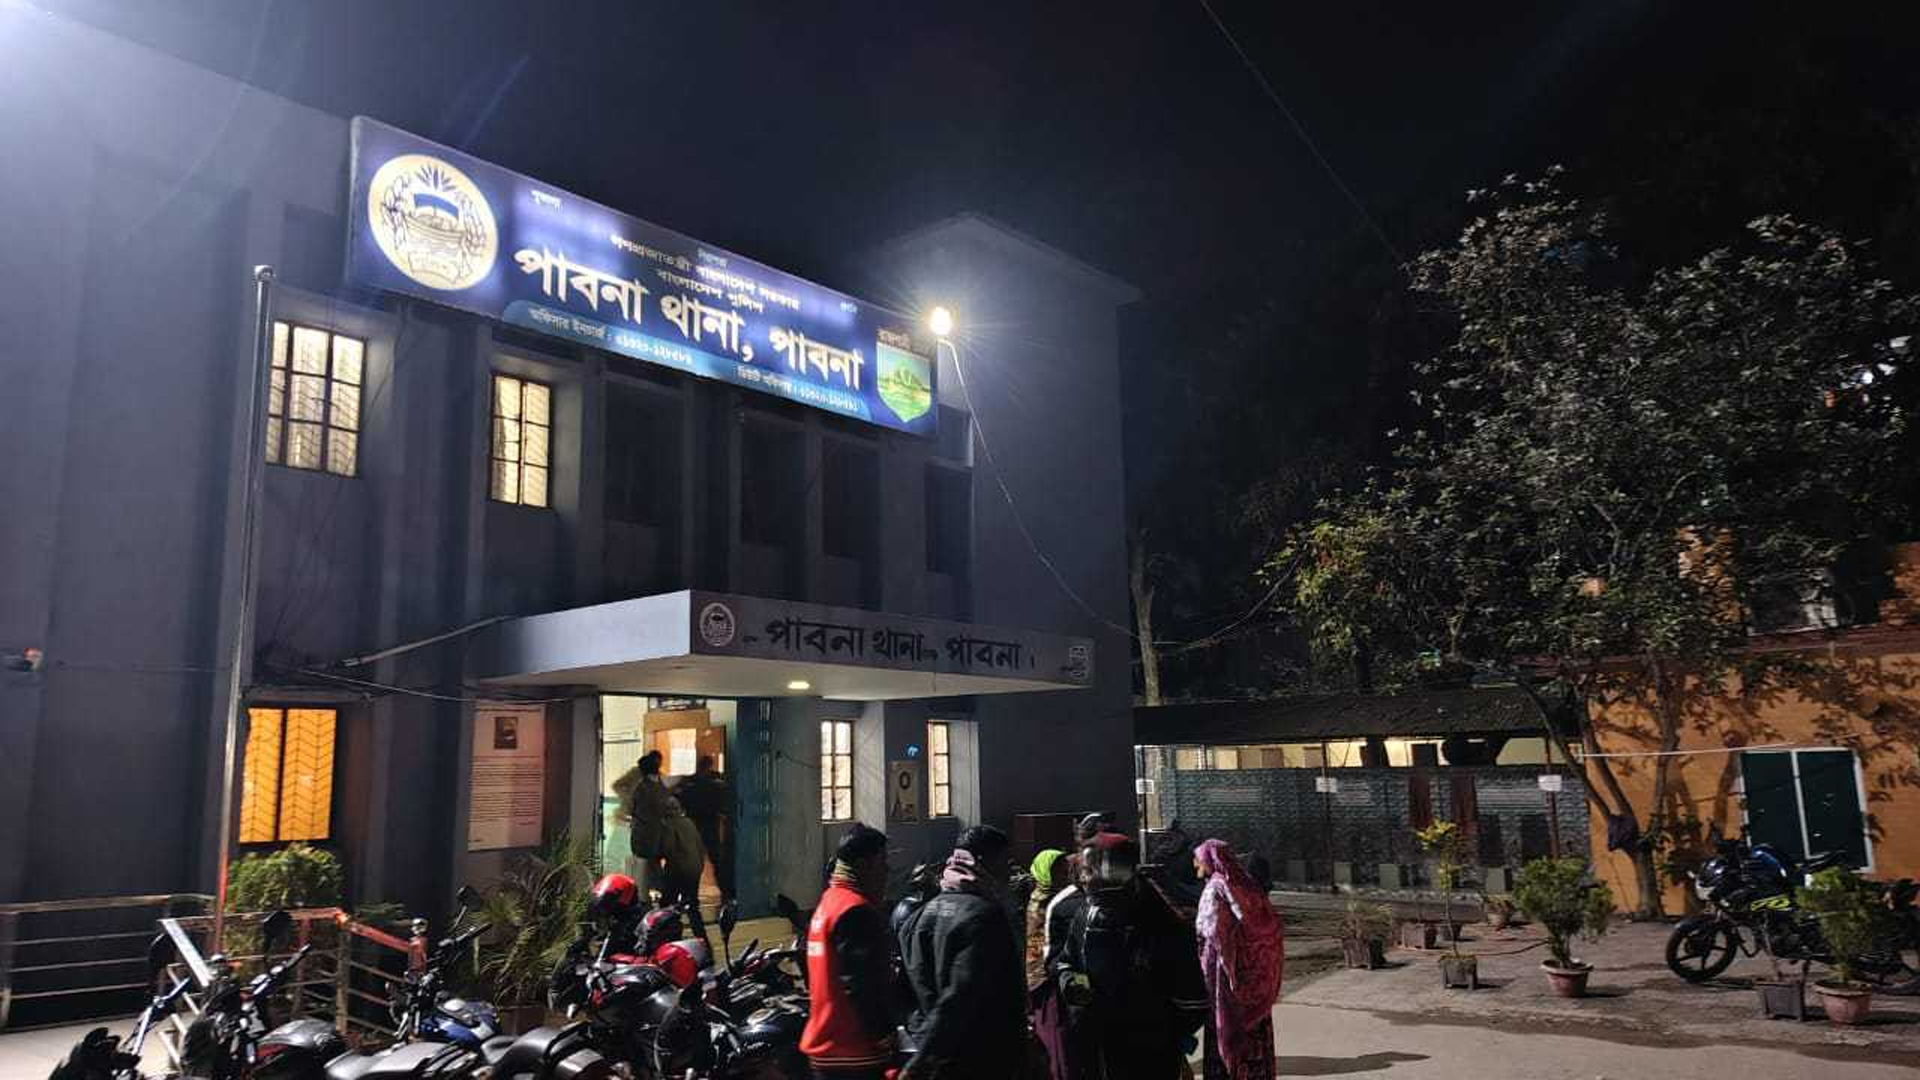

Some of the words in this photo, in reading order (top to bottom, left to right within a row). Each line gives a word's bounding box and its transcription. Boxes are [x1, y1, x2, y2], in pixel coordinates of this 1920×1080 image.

[656, 269, 724, 299] বাংলাদেশ
[514, 245, 649, 325] পাবনা
[660, 292, 754, 363] থানা,
[769, 326, 865, 391] পাবনা
[765, 616, 865, 657] পাবনা
[945, 632, 1023, 671] পাবনা
